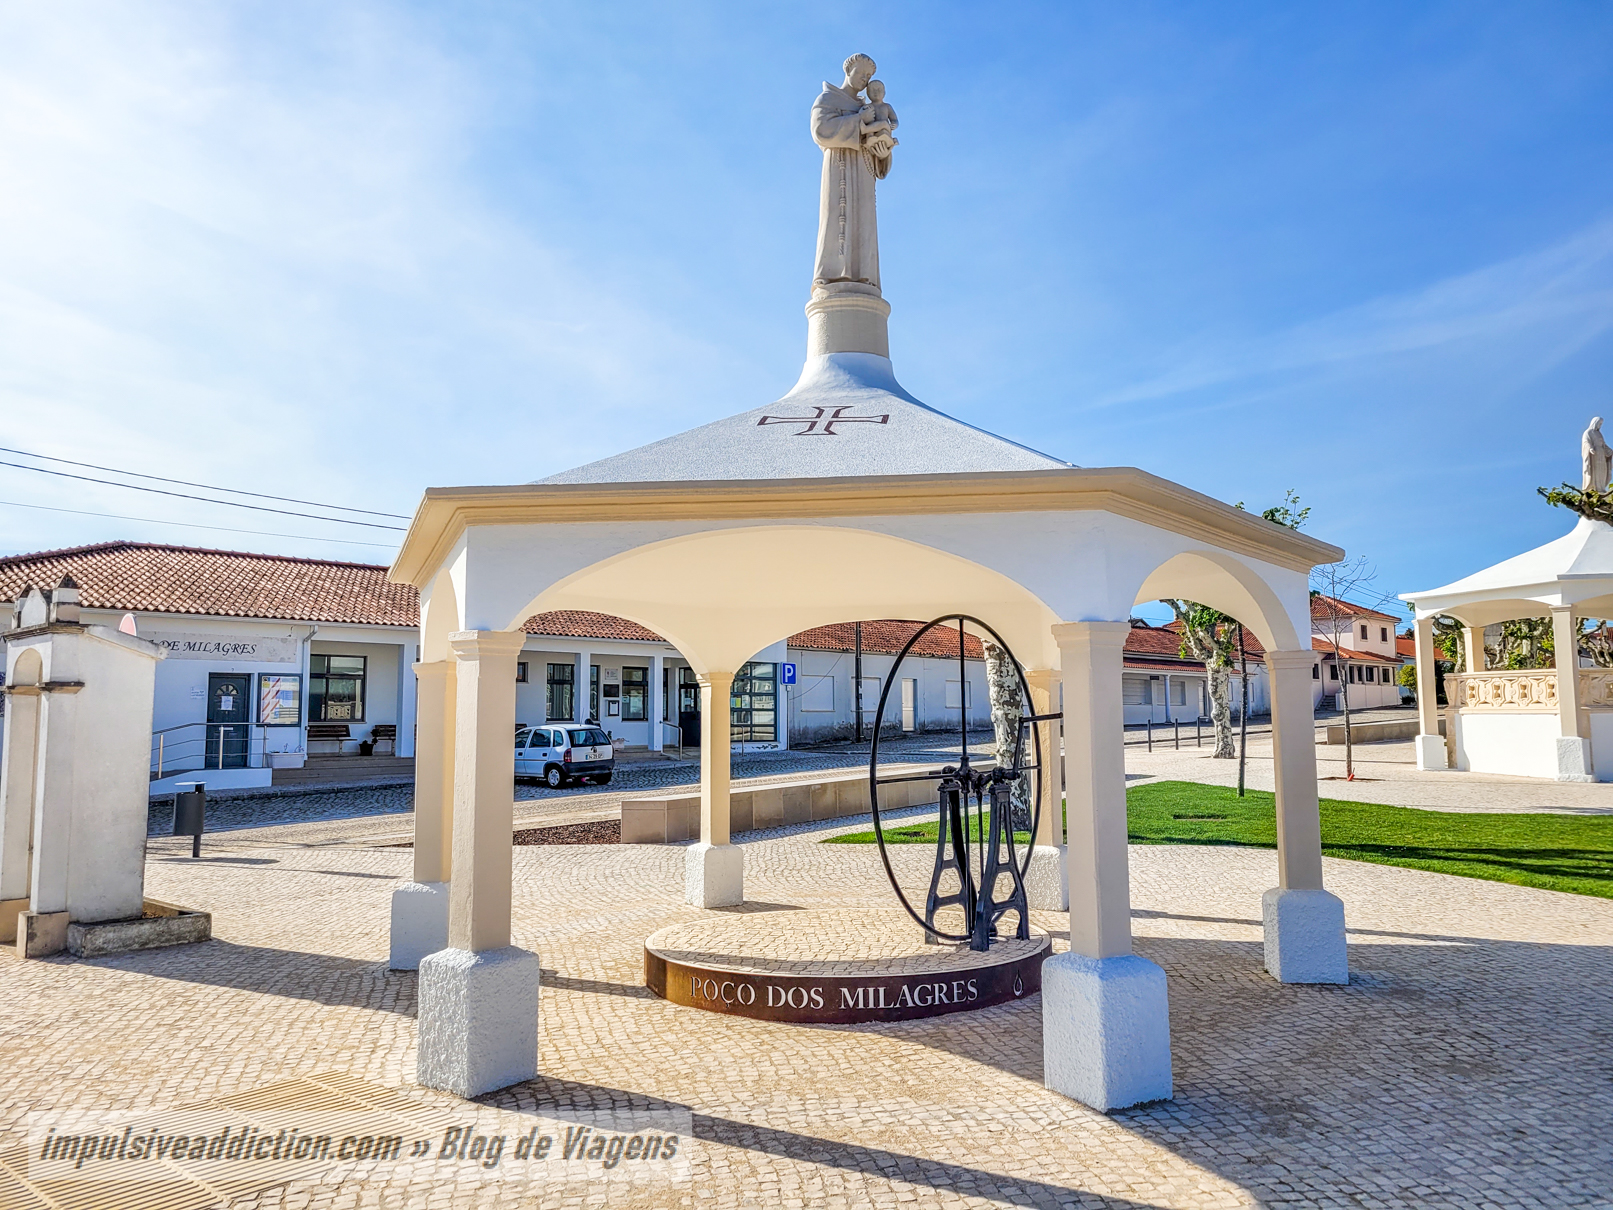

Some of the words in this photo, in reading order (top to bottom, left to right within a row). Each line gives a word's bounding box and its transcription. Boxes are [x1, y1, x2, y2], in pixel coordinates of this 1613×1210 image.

[159, 640, 180, 651] DE
[183, 641, 257, 656] MILAGRES
[784, 664, 794, 683] P
[690, 976, 756, 1008] POÇO
[766, 985, 824, 1010] DOS
[839, 978, 979, 1011] MILAGRES
